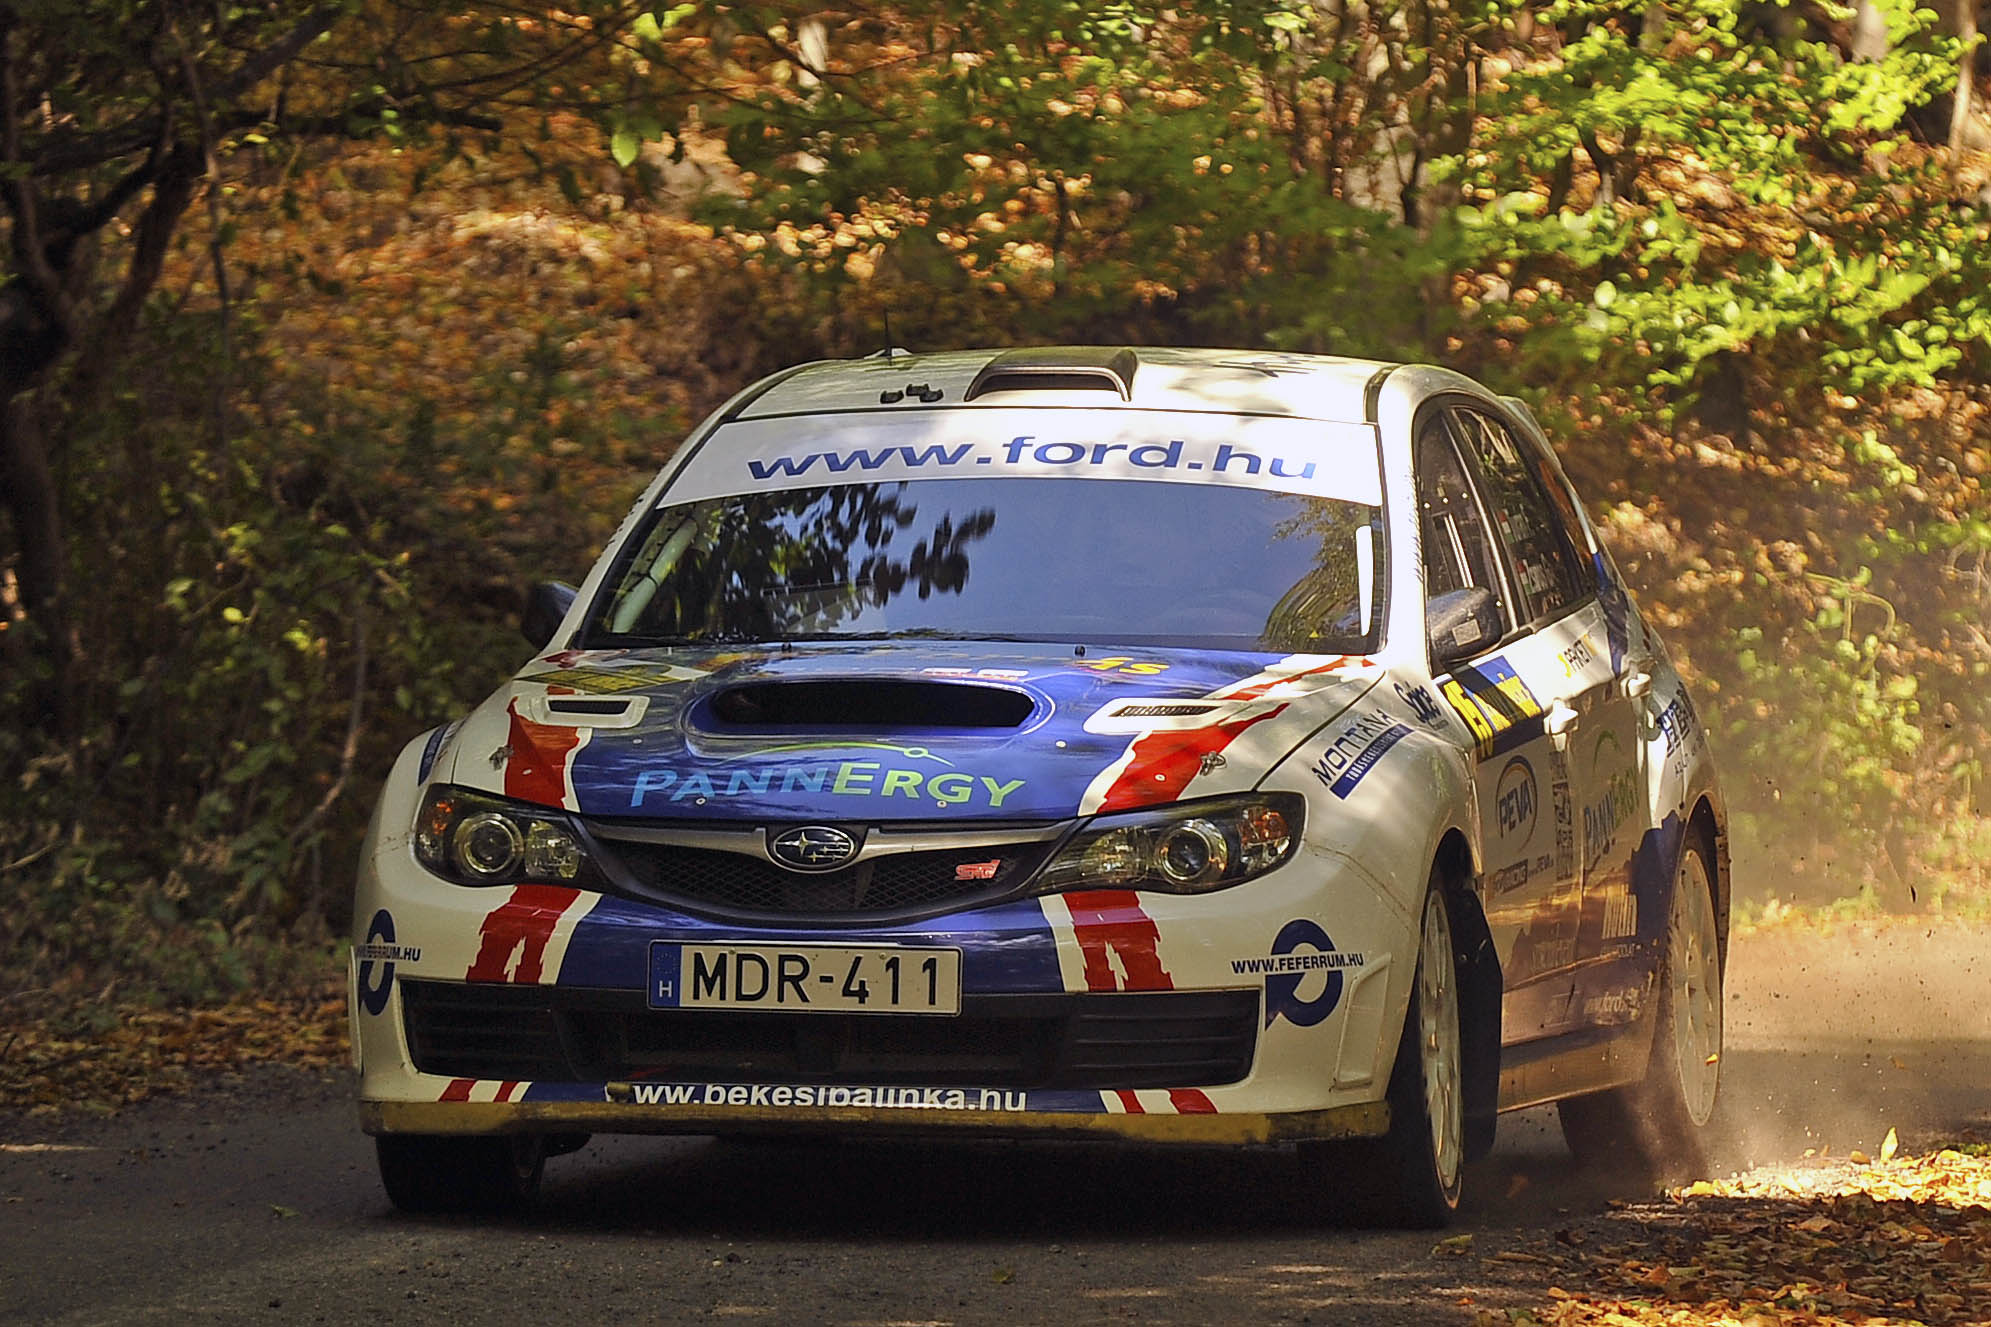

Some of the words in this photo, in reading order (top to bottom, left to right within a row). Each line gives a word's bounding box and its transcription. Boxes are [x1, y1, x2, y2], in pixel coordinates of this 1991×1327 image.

[748, 436, 1316, 480] www.ford.hu
[1312, 708, 1397, 786] MONTANA
[630, 762, 1027, 807] PANNERGY
[1498, 779, 1533, 840] PEVA
[692, 951, 937, 1006] MDR-411
[1231, 953, 1364, 974] WWW.FEFERRUM.HU
[659, 980, 673, 998] H
[604, 1083, 1027, 1111] ww.bekesipalinka.hu
